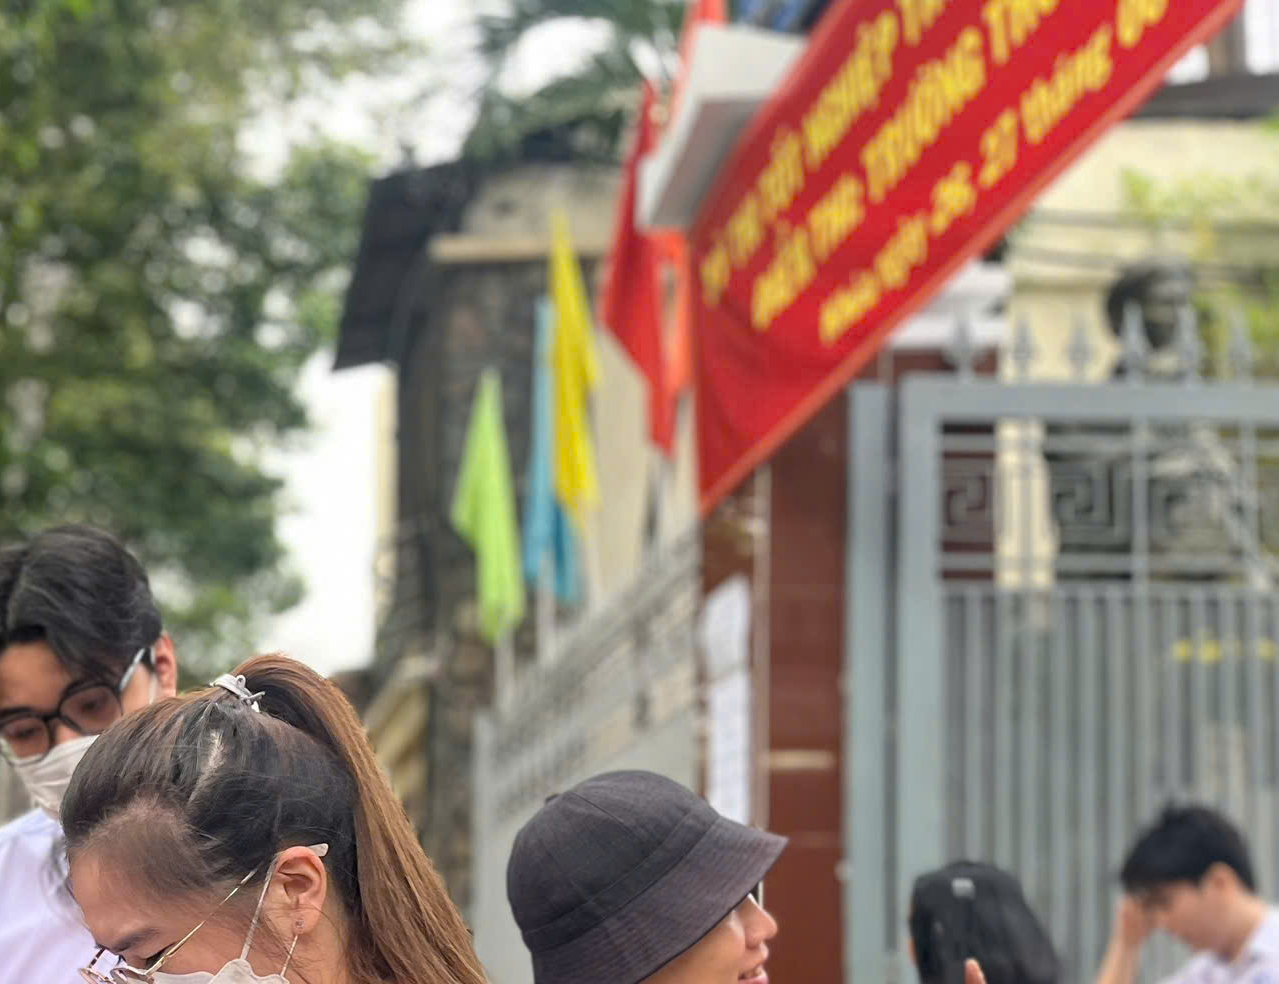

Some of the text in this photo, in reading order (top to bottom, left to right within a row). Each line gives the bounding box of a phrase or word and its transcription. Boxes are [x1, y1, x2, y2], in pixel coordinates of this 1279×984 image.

[802, 10, 899, 170] NGHIỆP
[978, 111, 1017, 188] 27
[1019, 25, 1114, 144] tháng
